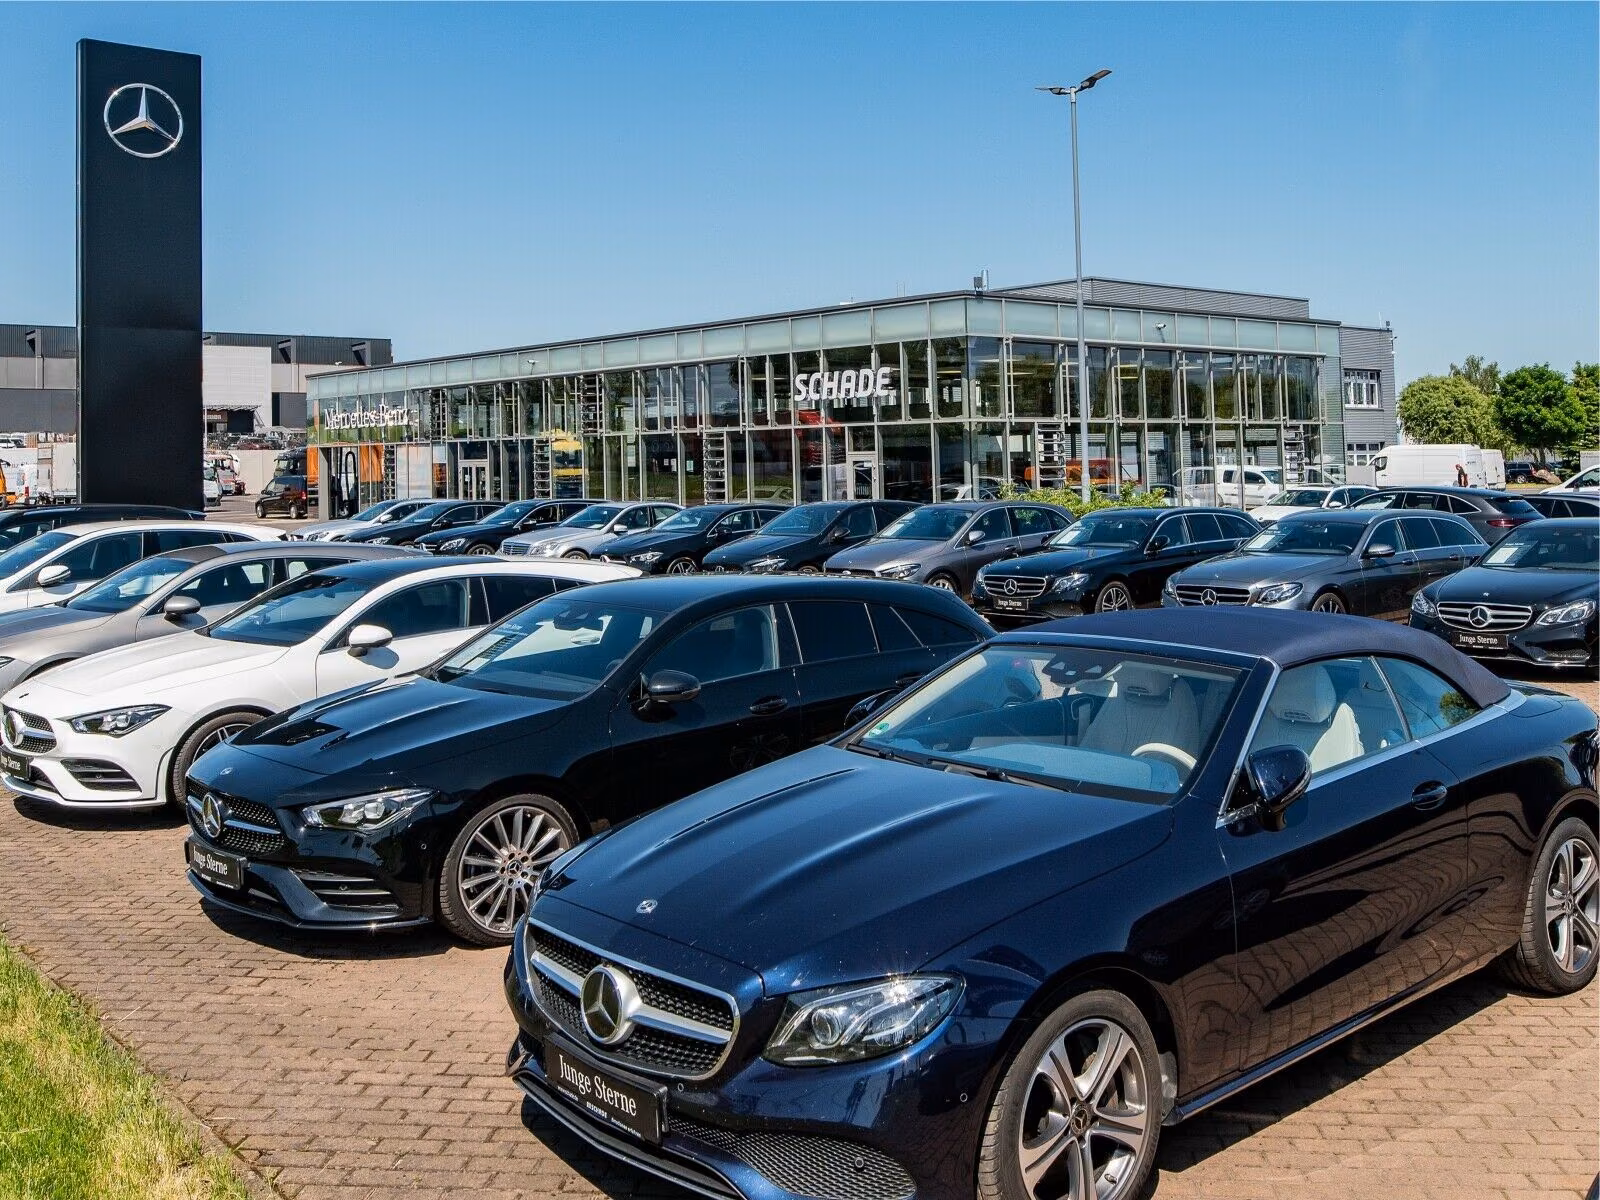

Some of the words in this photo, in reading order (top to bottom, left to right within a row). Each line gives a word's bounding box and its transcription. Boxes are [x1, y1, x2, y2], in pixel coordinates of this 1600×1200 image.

[794, 367, 891, 401] SCHADE
[324, 403, 409, 430] Mercedes-Benz
[1459, 634, 1476, 645] Junge
[1476, 635, 1498, 645] Sterne
[206, 853, 228, 876] Sterne
[558, 1054, 592, 1095] Junge
[593, 1075, 637, 1117] Sterne
